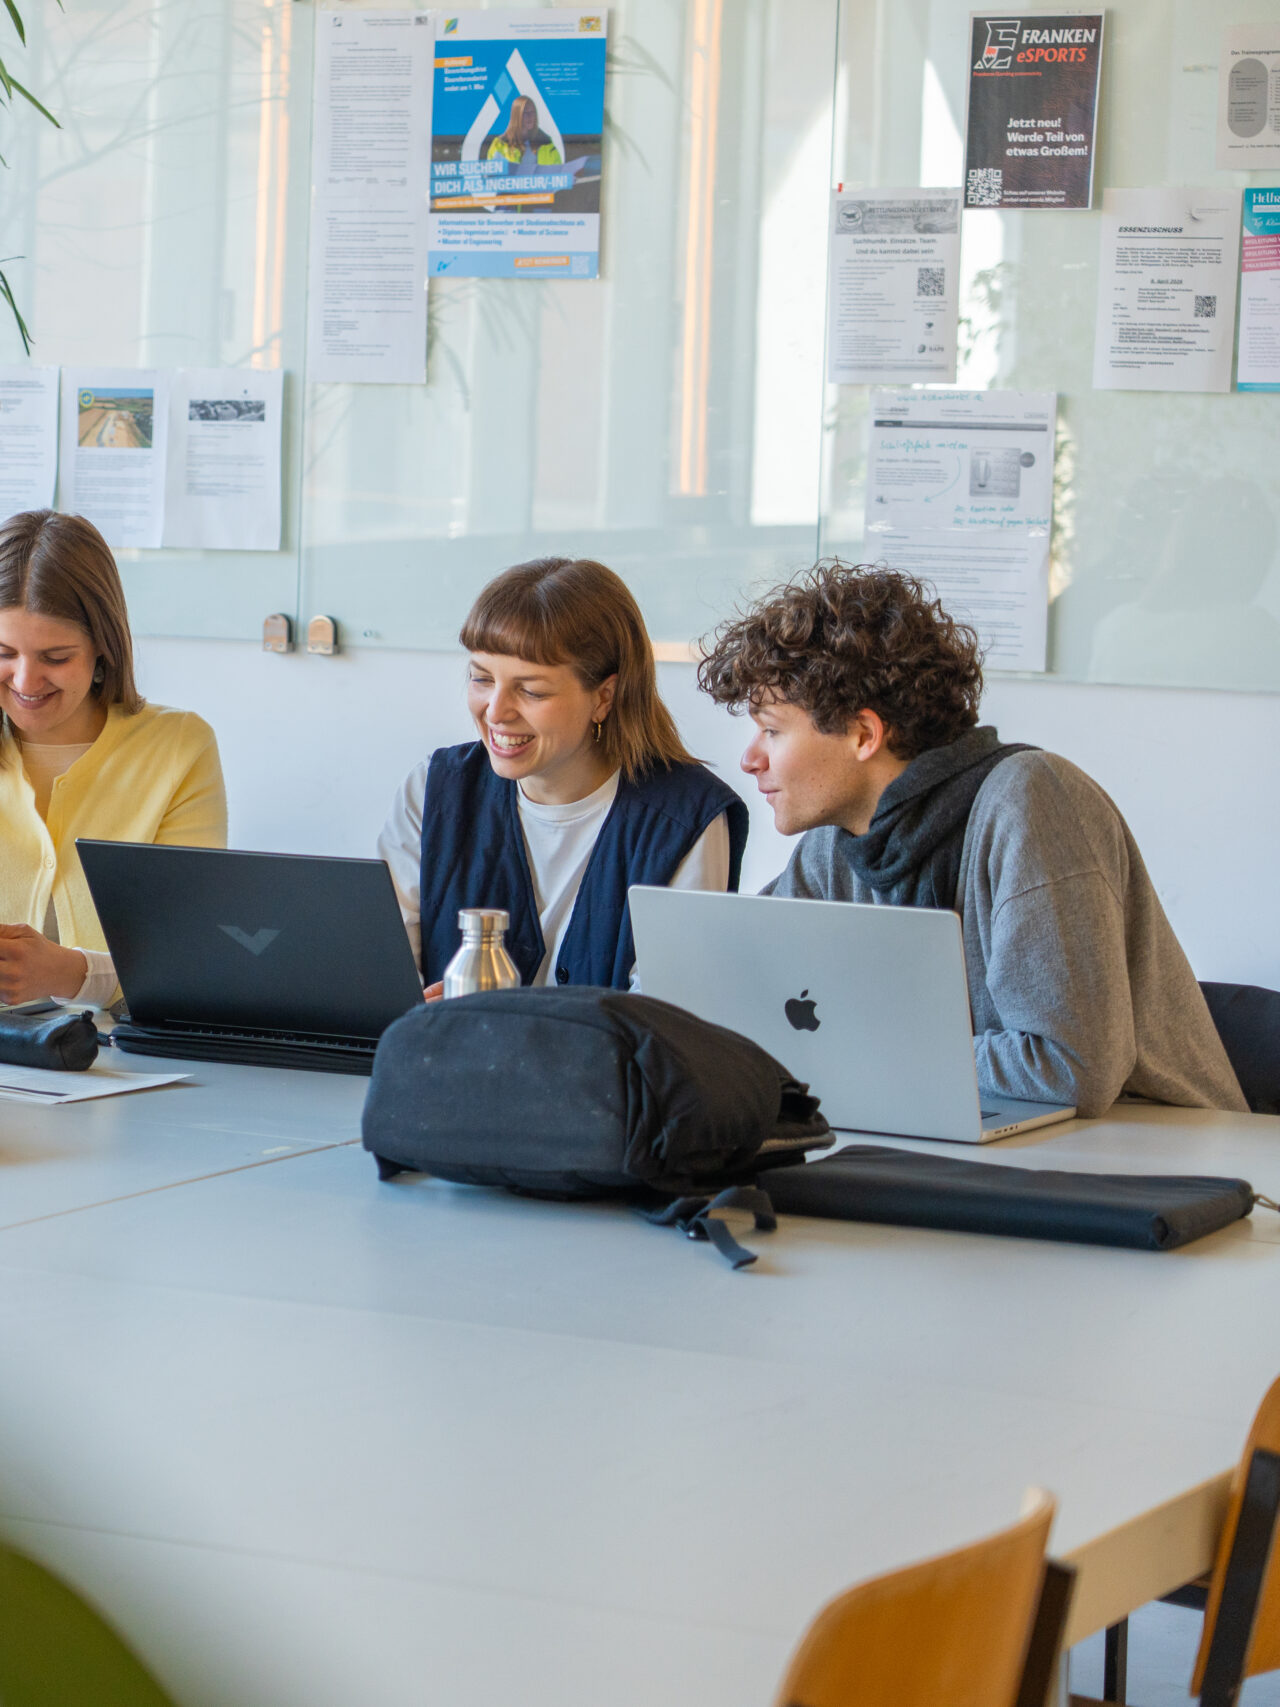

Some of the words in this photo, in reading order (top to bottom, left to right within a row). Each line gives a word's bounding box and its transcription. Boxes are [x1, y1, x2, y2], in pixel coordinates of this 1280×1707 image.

[1021, 29, 1097, 44] FRANKEN
[1016, 47, 1088, 62] eSPORTS
[1006, 117, 1036, 128] Jetzt
[1037, 117, 1062, 128] neu!
[1006, 131, 1044, 142] Werde
[1045, 131, 1064, 142] Teil
[1065, 133, 1085, 142] von
[1006, 146, 1039, 156] etwas
[1040, 145, 1088, 156] Großem!
[434, 163, 457, 176] WIR
[458, 161, 503, 175] SUCHEN
[434, 181, 461, 194] DICH
[462, 179, 484, 192] ALS
